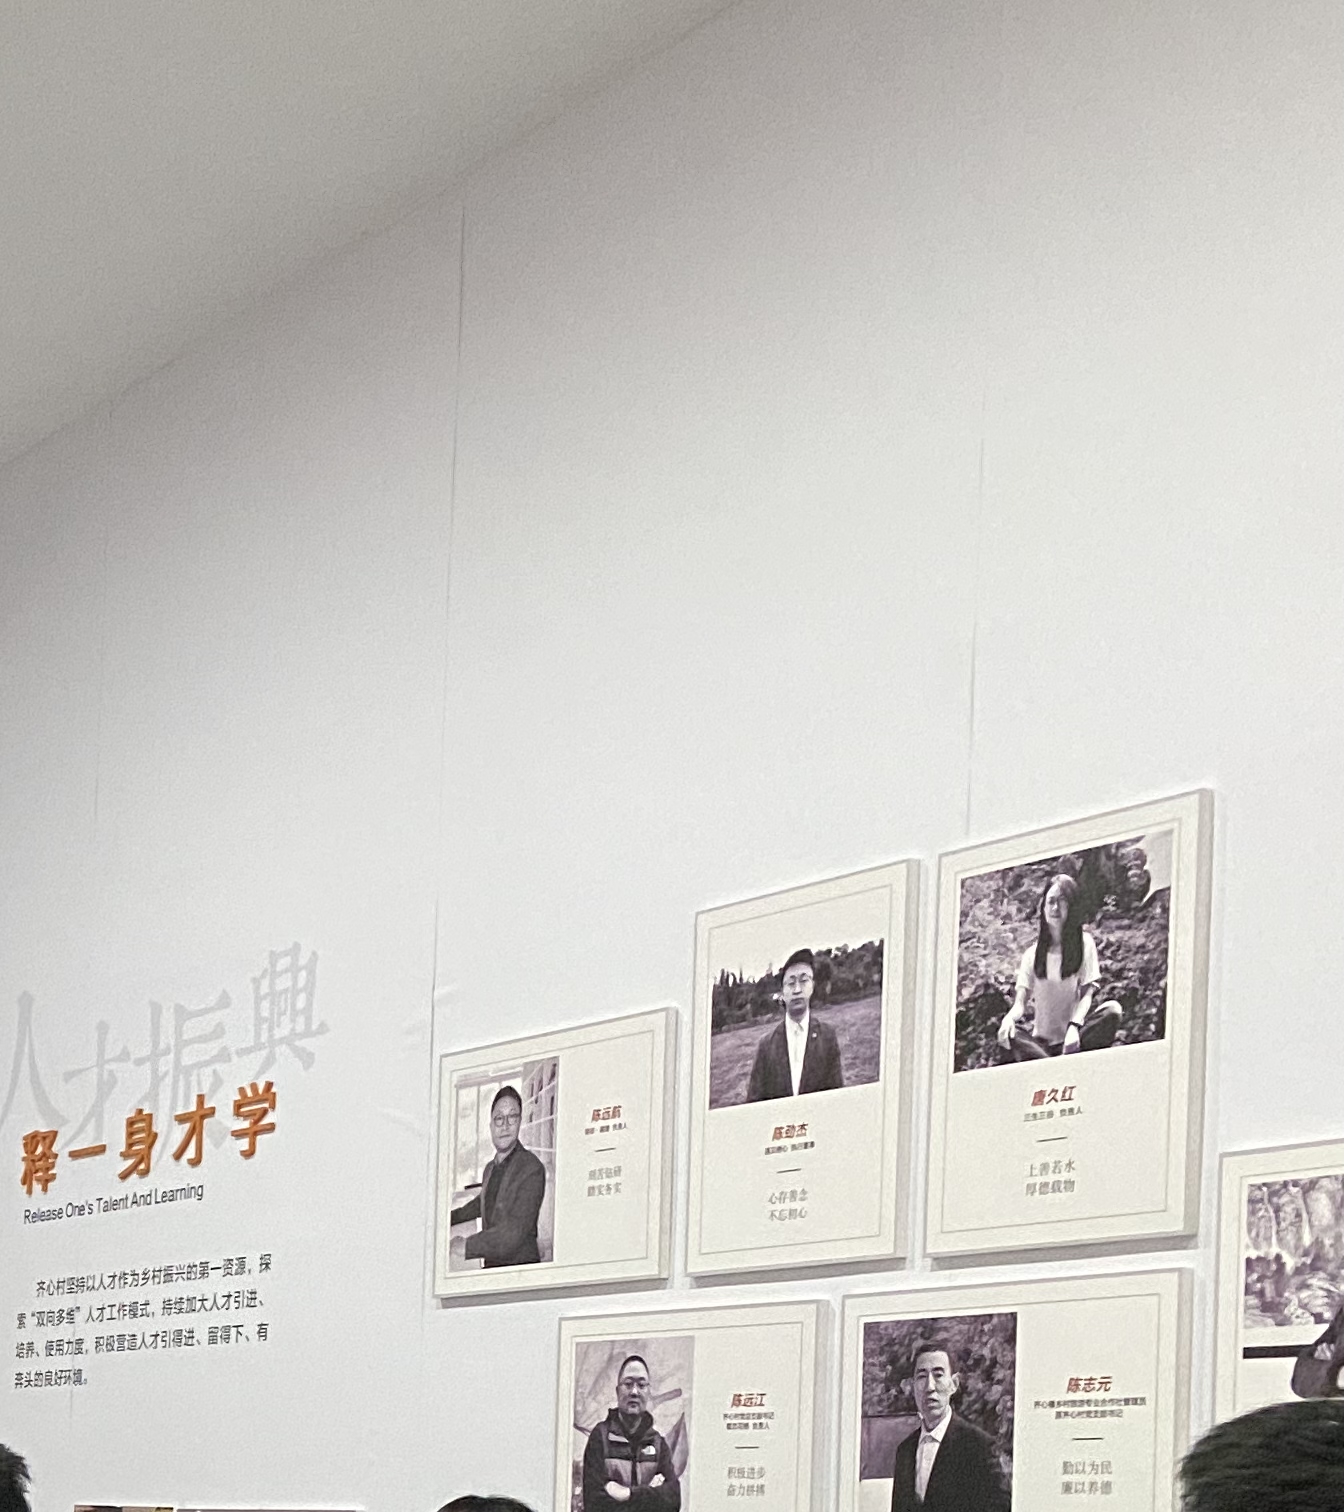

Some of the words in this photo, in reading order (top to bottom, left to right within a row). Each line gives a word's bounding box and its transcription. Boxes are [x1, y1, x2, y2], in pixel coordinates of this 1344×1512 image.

[21, 1080, 278, 1196] 释一身才学
[1027, 1159, 1076, 1178] 上善若水
[1025, 1179, 1076, 1197] 厚德载物
[23, 1208, 64, 1225] Release
[96, 1195, 129, 1214] Talent
[130, 1190, 152, 1208] And
[154, 1183, 204, 1204] Learning
[1066, 1376, 1113, 1394] 陈志元
